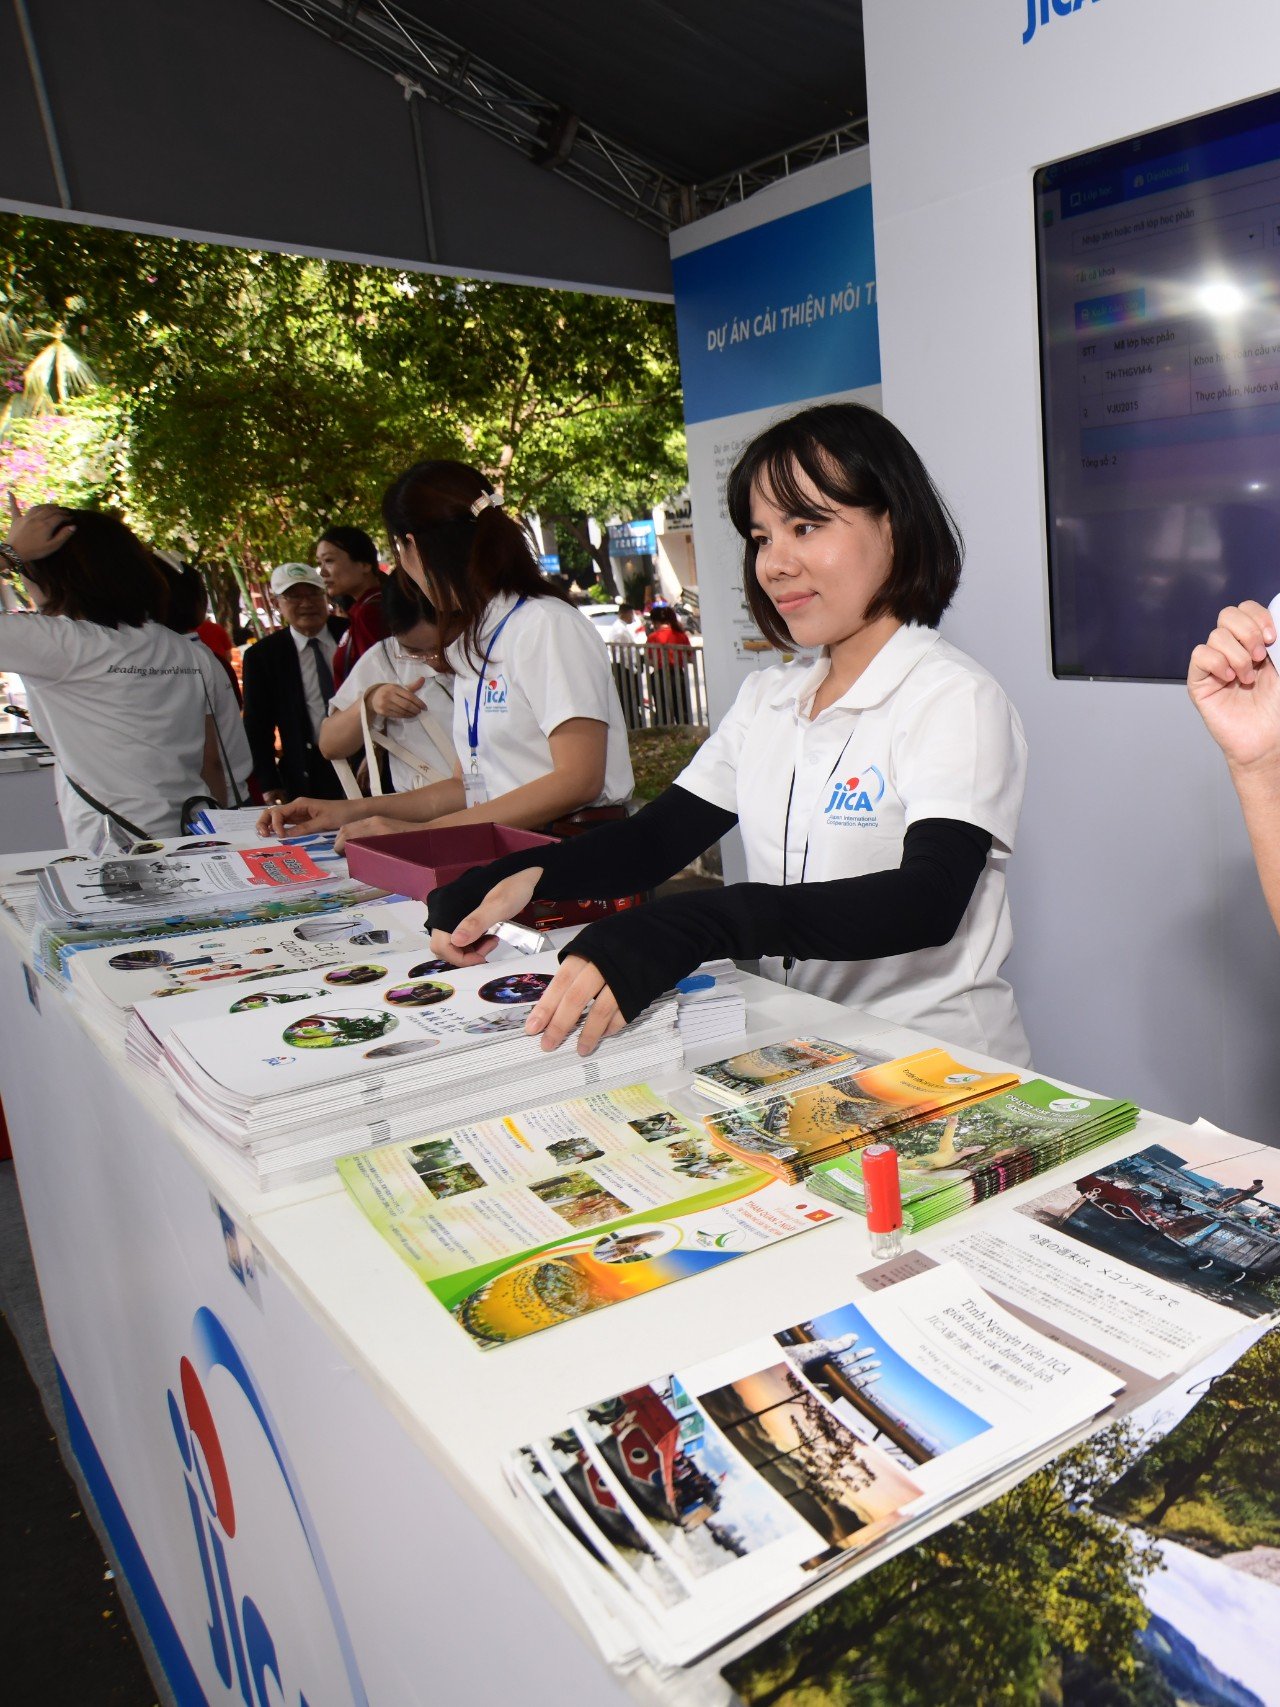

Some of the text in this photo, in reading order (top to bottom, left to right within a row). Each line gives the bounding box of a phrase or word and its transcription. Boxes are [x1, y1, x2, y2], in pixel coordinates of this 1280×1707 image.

[707, 321, 728, 352] DỰ
[729, 316, 750, 344] ÁN
[753, 305, 777, 337] CẢI
[780, 293, 826, 328] THIỆN
[830, 281, 860, 316] MÔI
[961, 1298, 985, 1320] Tình
[1021, 1343, 1046, 1362] Viên
[1045, 1356, 1072, 1376] JICA
[1021, 1361, 1036, 1374] du
